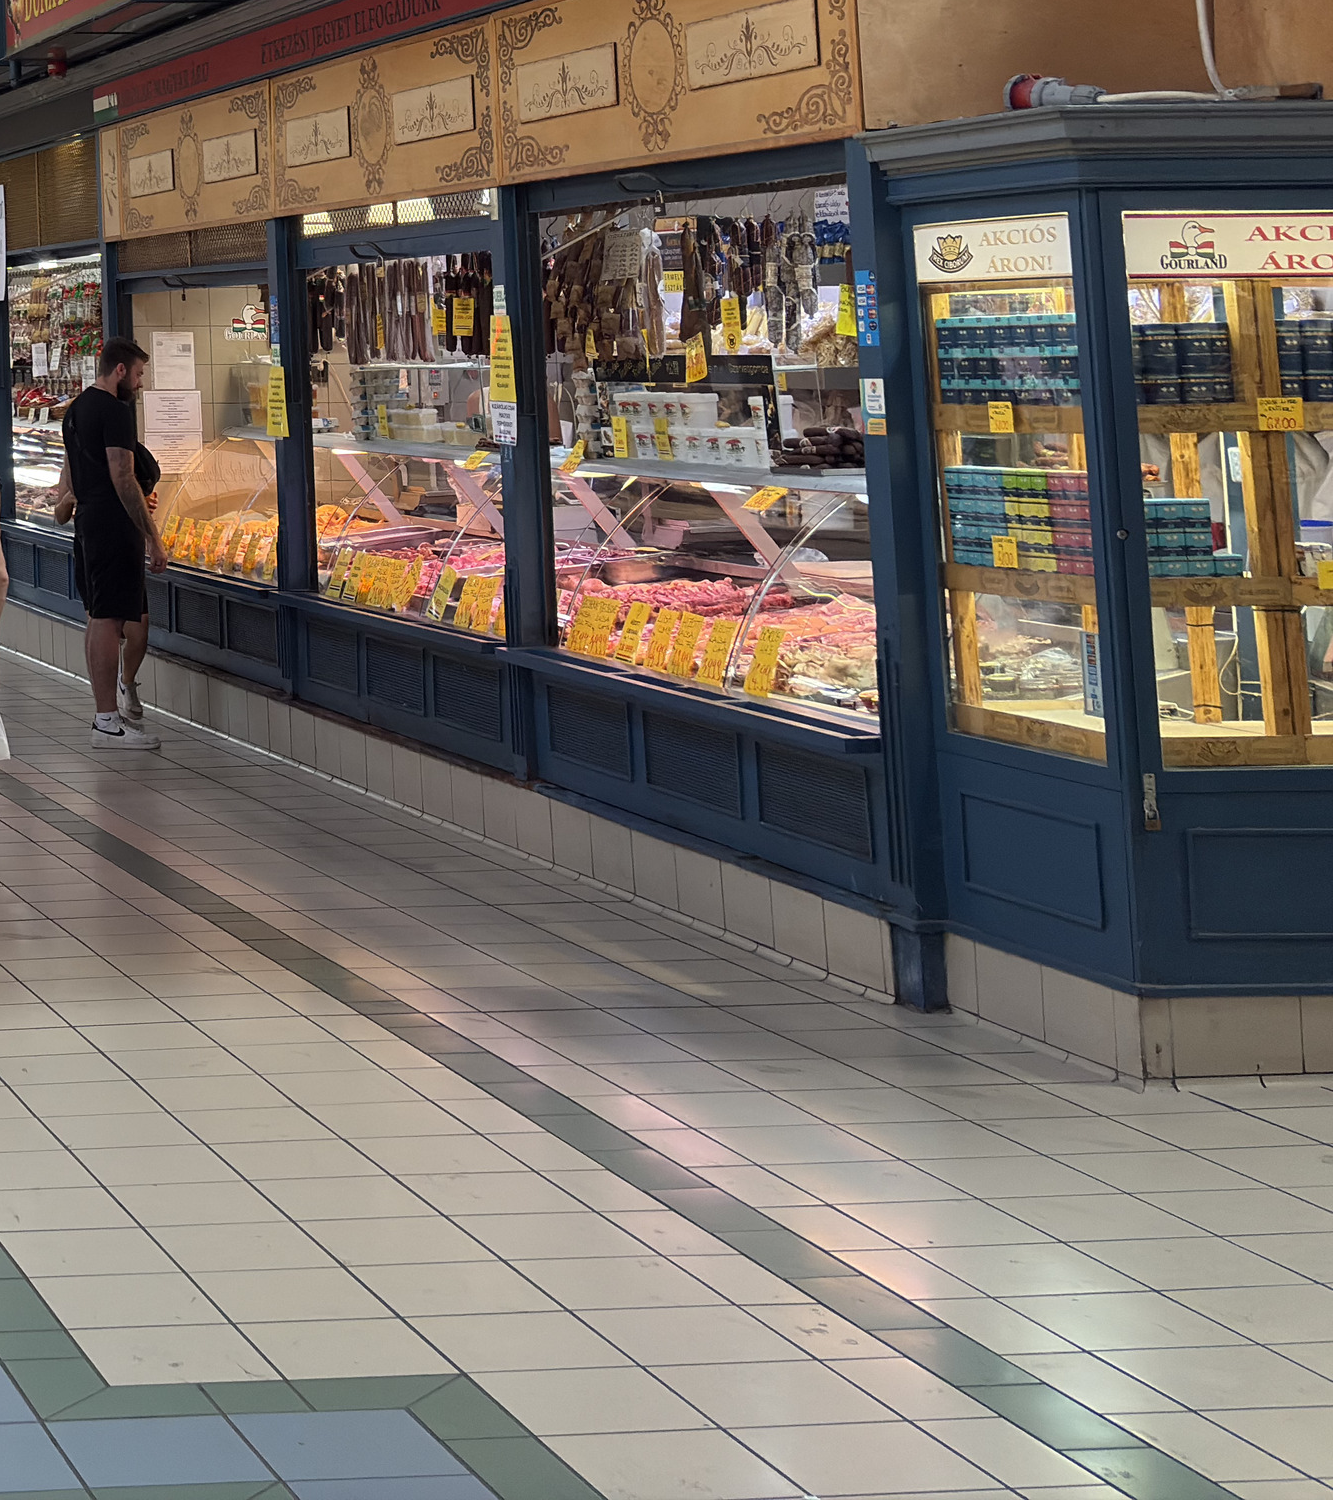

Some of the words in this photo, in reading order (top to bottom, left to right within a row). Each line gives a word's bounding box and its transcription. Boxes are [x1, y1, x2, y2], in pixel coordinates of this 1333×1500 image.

[260, 30, 311, 65] ÉTKEZÉSI
[310, 15, 353, 53] JEGYET
[979, 224, 1057, 247] AKCIÓS
[986, 255, 1053, 274] ÁRON!
[1160, 254, 1228, 270] GOURLAND
[225, 329, 268, 341] GOURLAN
